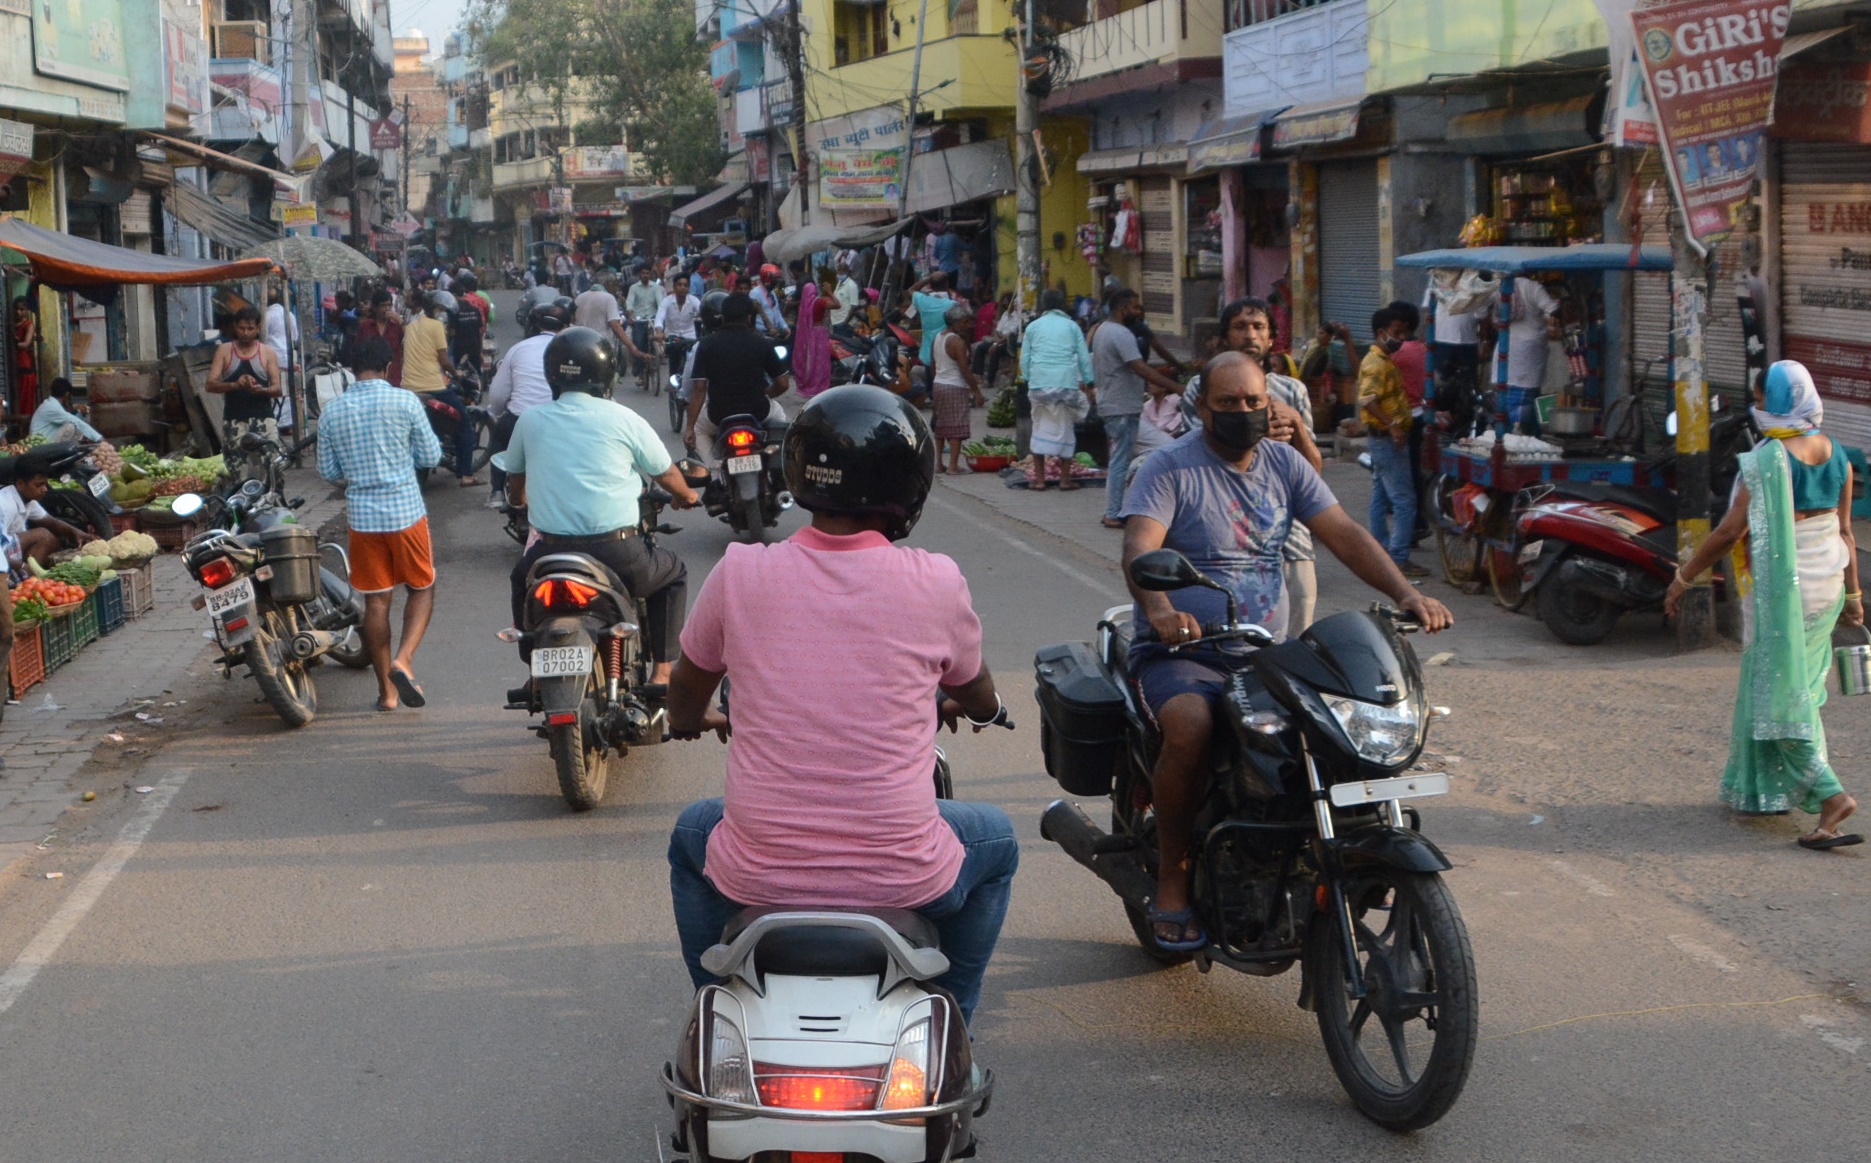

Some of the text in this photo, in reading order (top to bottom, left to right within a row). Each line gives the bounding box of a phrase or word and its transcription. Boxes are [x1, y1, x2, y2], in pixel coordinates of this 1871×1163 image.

[805, 464, 842, 485] STUDDS
[211, 591, 249, 611] 8479
[542, 648, 584, 662] BR02A
